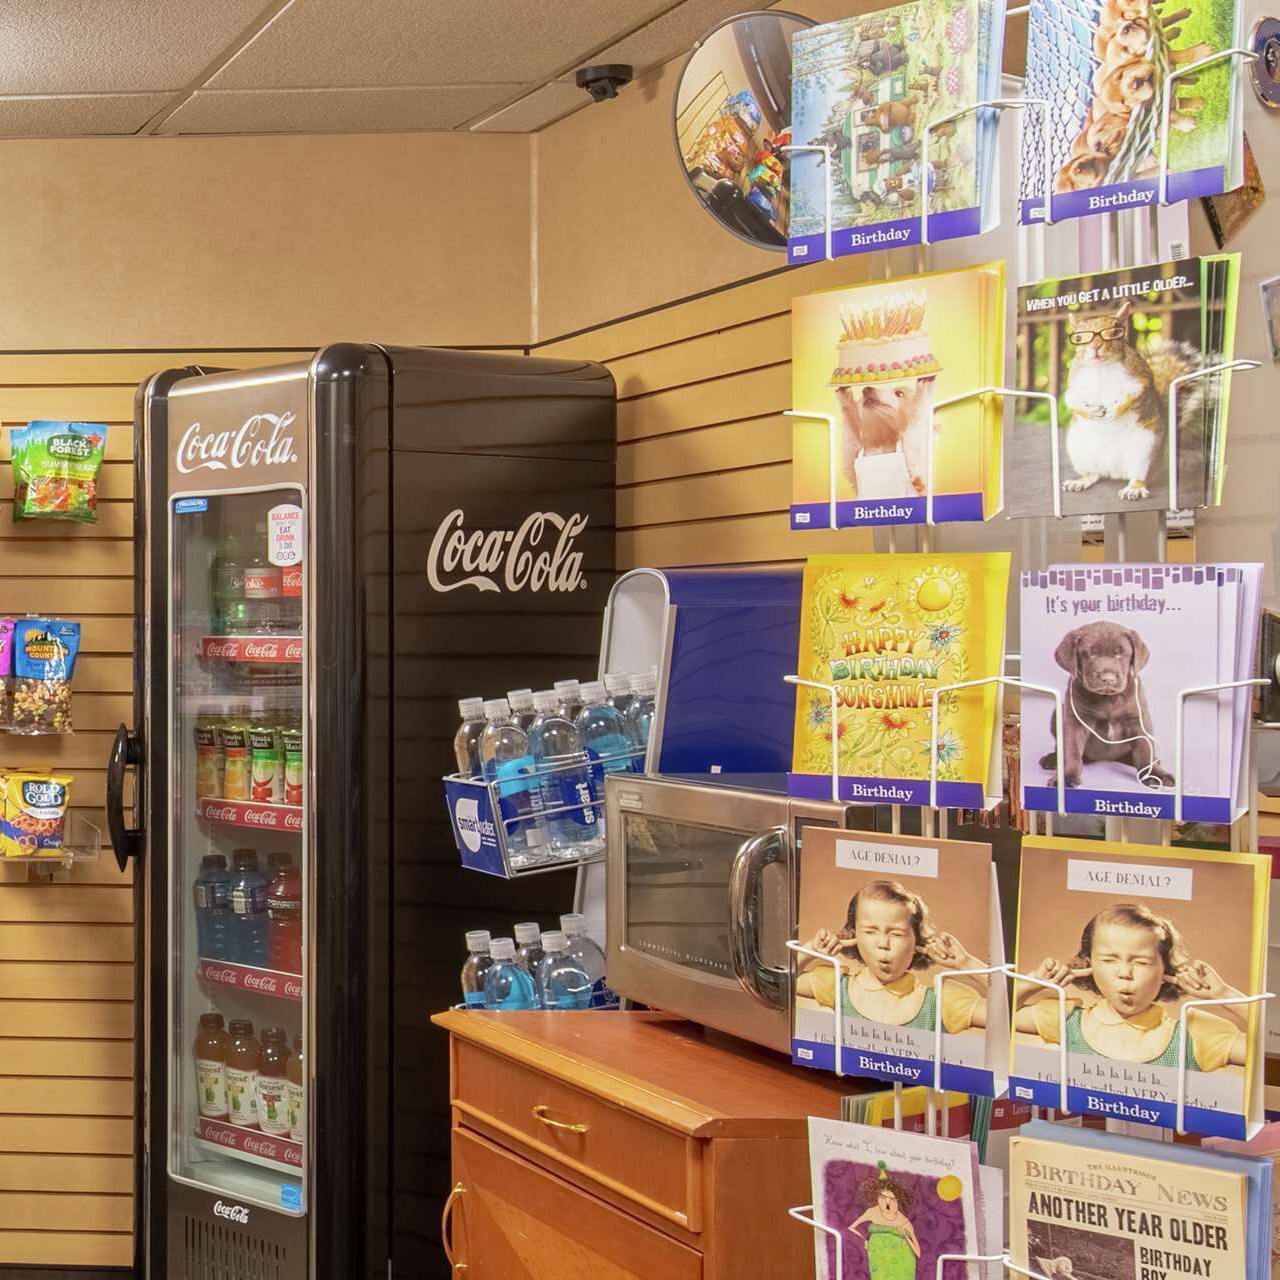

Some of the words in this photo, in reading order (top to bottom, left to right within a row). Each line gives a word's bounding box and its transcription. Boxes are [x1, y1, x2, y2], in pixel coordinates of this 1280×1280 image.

[1089, 188, 1155, 209] Birthday
[851, 227, 911, 248] Birthday
[1026, 295, 1056, 311] WHEN
[1057, 292, 1077, 307] YOU
[1078, 289, 1100, 303] GET
[1101, 289, 1110, 300] A
[1113, 281, 1150, 299] LITTLE
[1153, 276, 1194, 292] OLDER...
[50, 446, 90, 456] FOREST
[52, 438, 86, 448] BLACK
[176, 411, 298, 474] Coca-Cola
[271, 511, 299, 521] BALANCE
[854, 505, 913, 520] Birthday
[427, 509, 589, 593] Coca-Cola
[1046, 595, 1067, 613] It's
[1073, 598, 1102, 616] your
[1107, 595, 1182, 615] birthday...
[843, 628, 927, 656] HAPPY
[829, 656, 946, 681] BIRTHDAY
[835, 683, 936, 709] SUNSHINE
[26, 790, 62, 805] GOLD
[29, 782, 62, 793] ROLD
[852, 784, 913, 802] Birthday
[1094, 800, 1162, 818] Birthday
[849, 850, 873, 863] AGE
[875, 852, 921, 867] DENIAL?
[1086, 870, 1113, 884] AGE
[1116, 872, 1171, 888] DENIAL?
[858, 1056, 922, 1079] Birthday
[1087, 1096, 1161, 1123] Birthday
[1105, 1163, 1156, 1181] ILLUSTRIOUS
[1025, 1160, 1141, 1196] BIRTHDAY
[1158, 1183, 1228, 1212] NEWS
[1029, 1192, 1108, 1228] ANOTHER
[1114, 1207, 1163, 1238] YEAR
[1170, 1218, 1228, 1251] OLDER
[1140, 1246, 1212, 1277] BIRTHDAY
